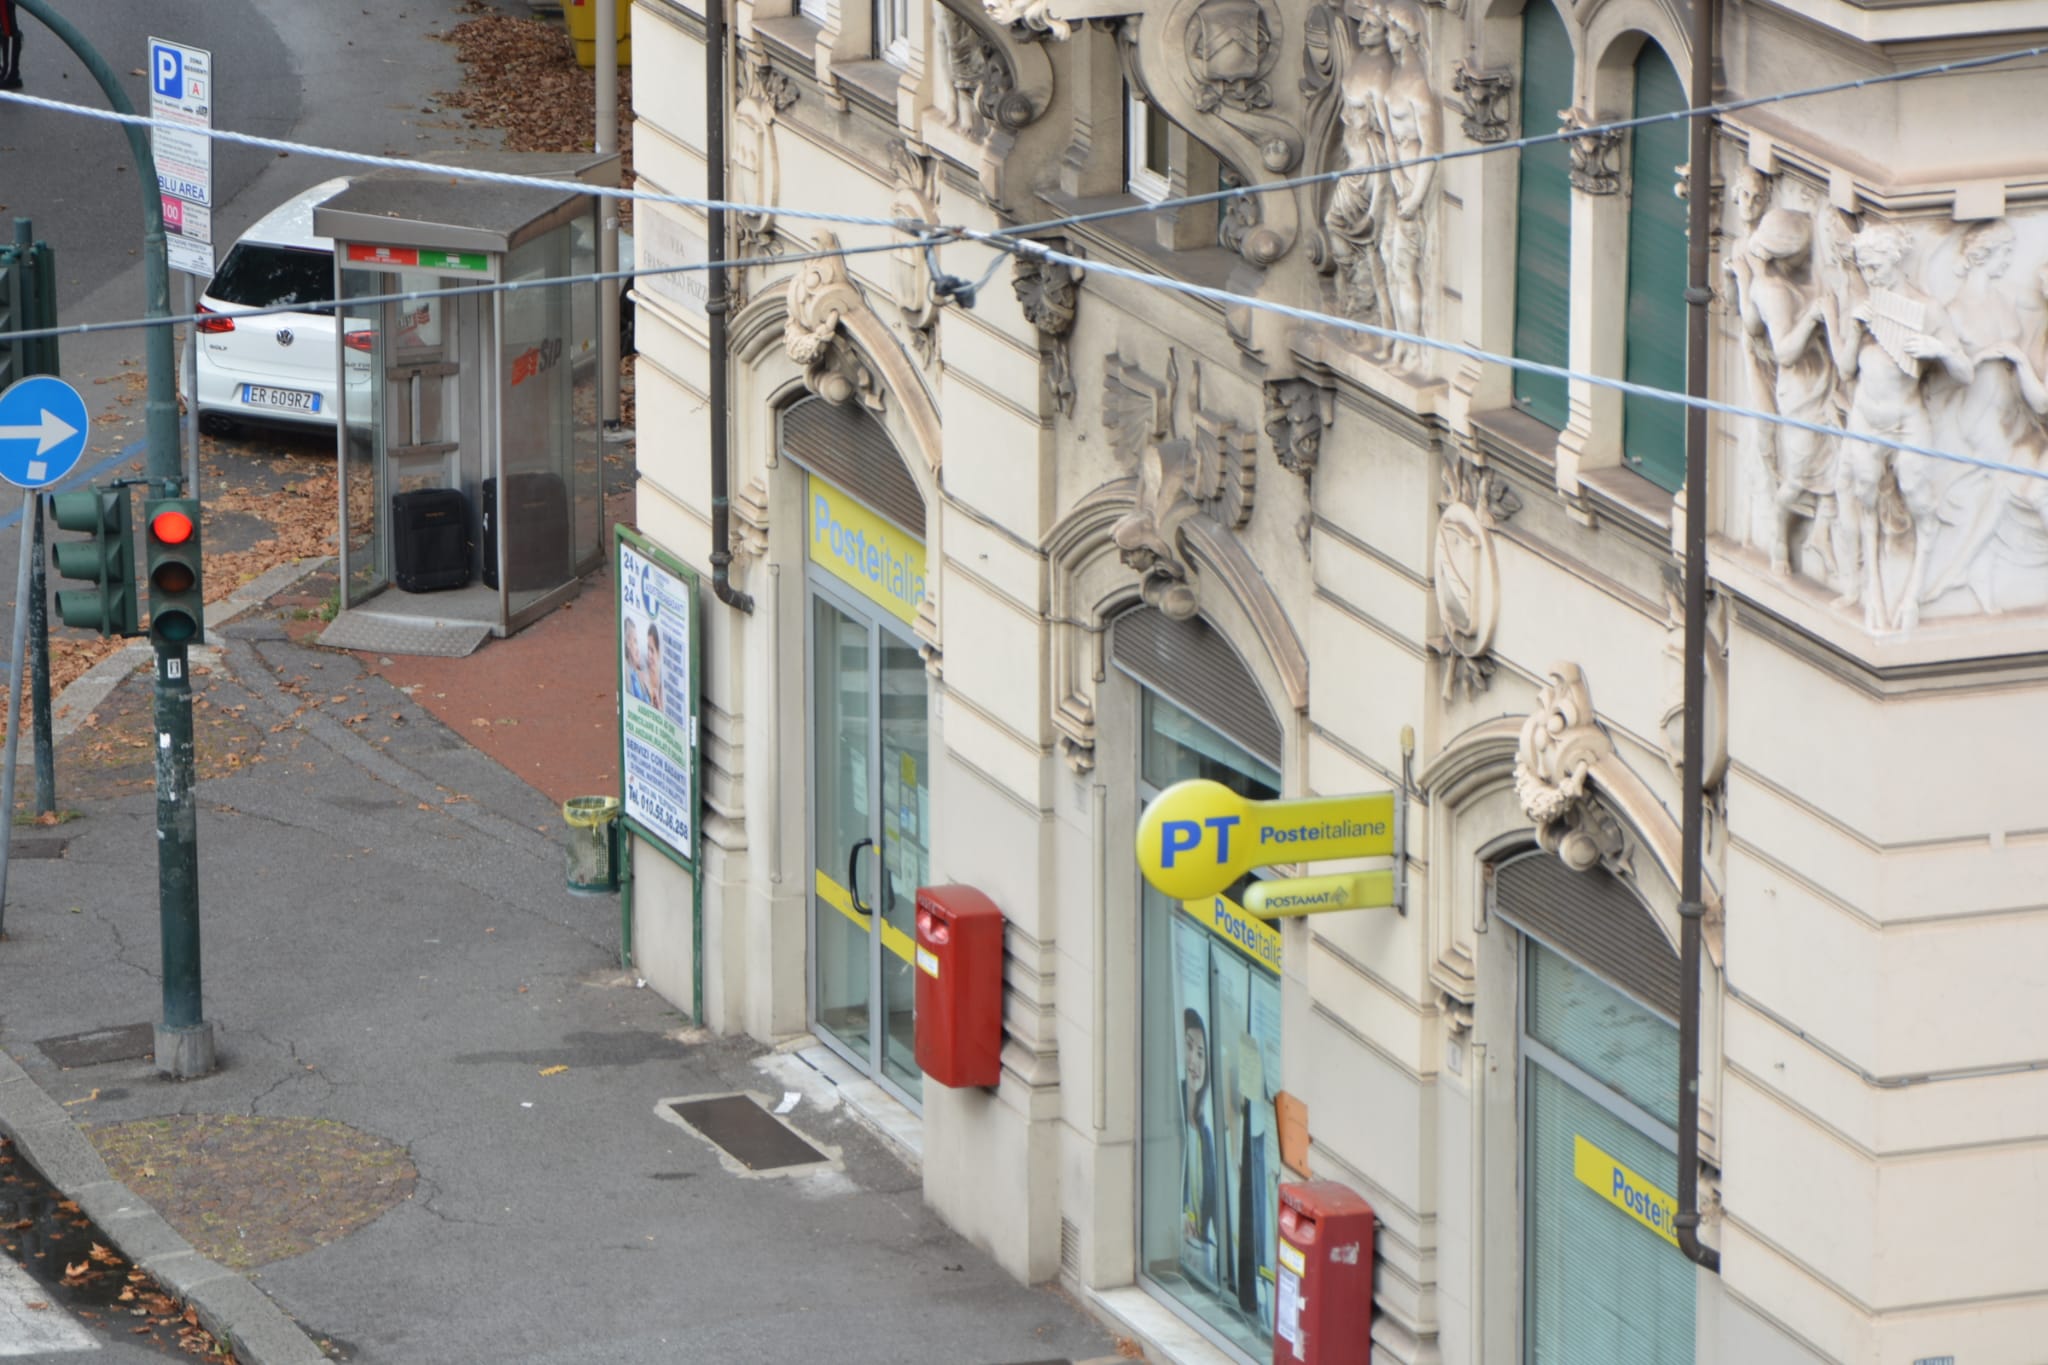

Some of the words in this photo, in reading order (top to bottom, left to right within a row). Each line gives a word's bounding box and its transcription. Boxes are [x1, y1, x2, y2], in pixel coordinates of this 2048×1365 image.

[158, 50, 177, 92] P
[192, 82, 200, 96] A
[158, 175, 177, 192] BLU
[178, 182, 205, 200] AREA
[250, 387, 267, 403] ER
[270, 390, 311, 409] 609RZ
[623, 551, 634, 574] 24
[623, 584, 634, 606] 24
[627, 738, 649, 760] SERVIZI
[650, 752, 663, 769] CON
[1160, 815, 1241, 869] PT
[1260, 819, 1386, 845] Posteitaliane
[1265, 892, 1330, 909] POSTAMAT
